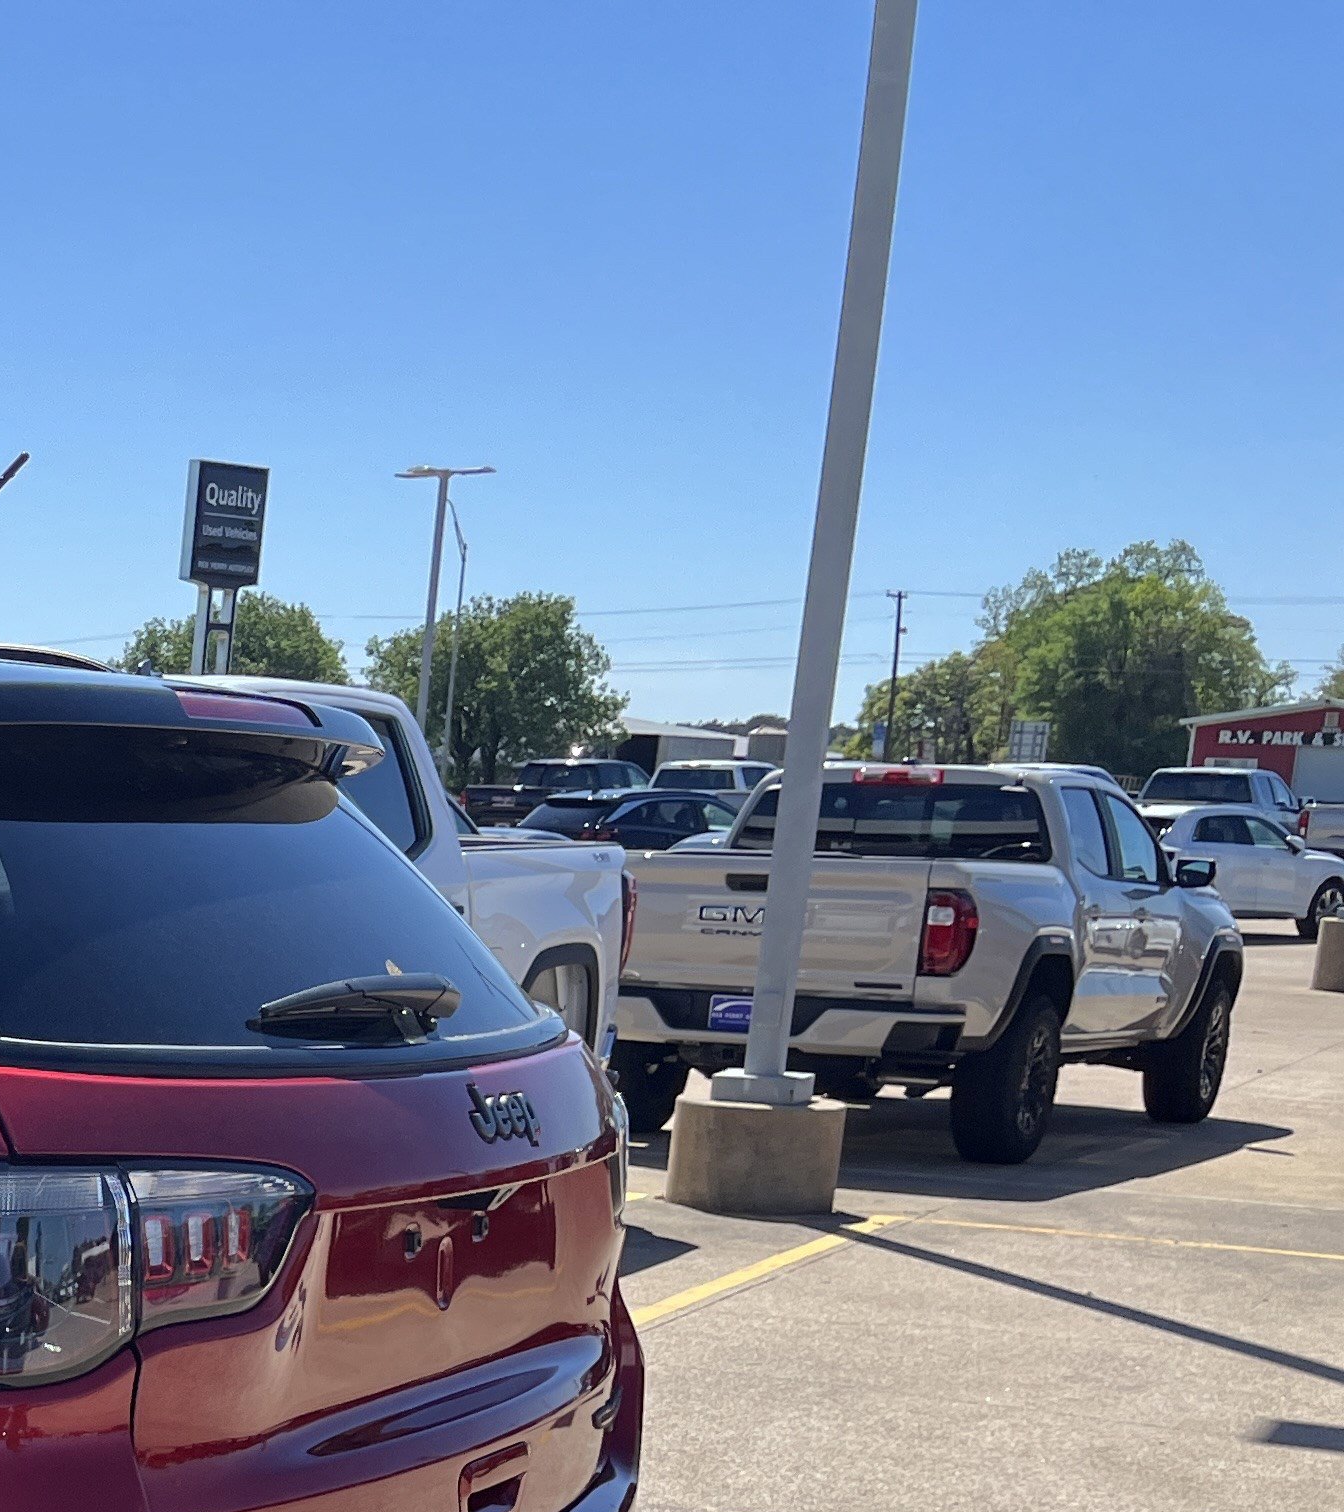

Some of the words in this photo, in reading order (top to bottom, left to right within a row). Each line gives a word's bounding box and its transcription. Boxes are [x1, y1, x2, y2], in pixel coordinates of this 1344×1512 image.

[205, 482, 262, 515] Quality
[1218, 729, 1255, 744] R.V.
[1262, 730, 1304, 746] PARK
[1312, 731, 1324, 747] &
[699, 905, 765, 924] GM
[465, 1081, 541, 1148] Jeep
